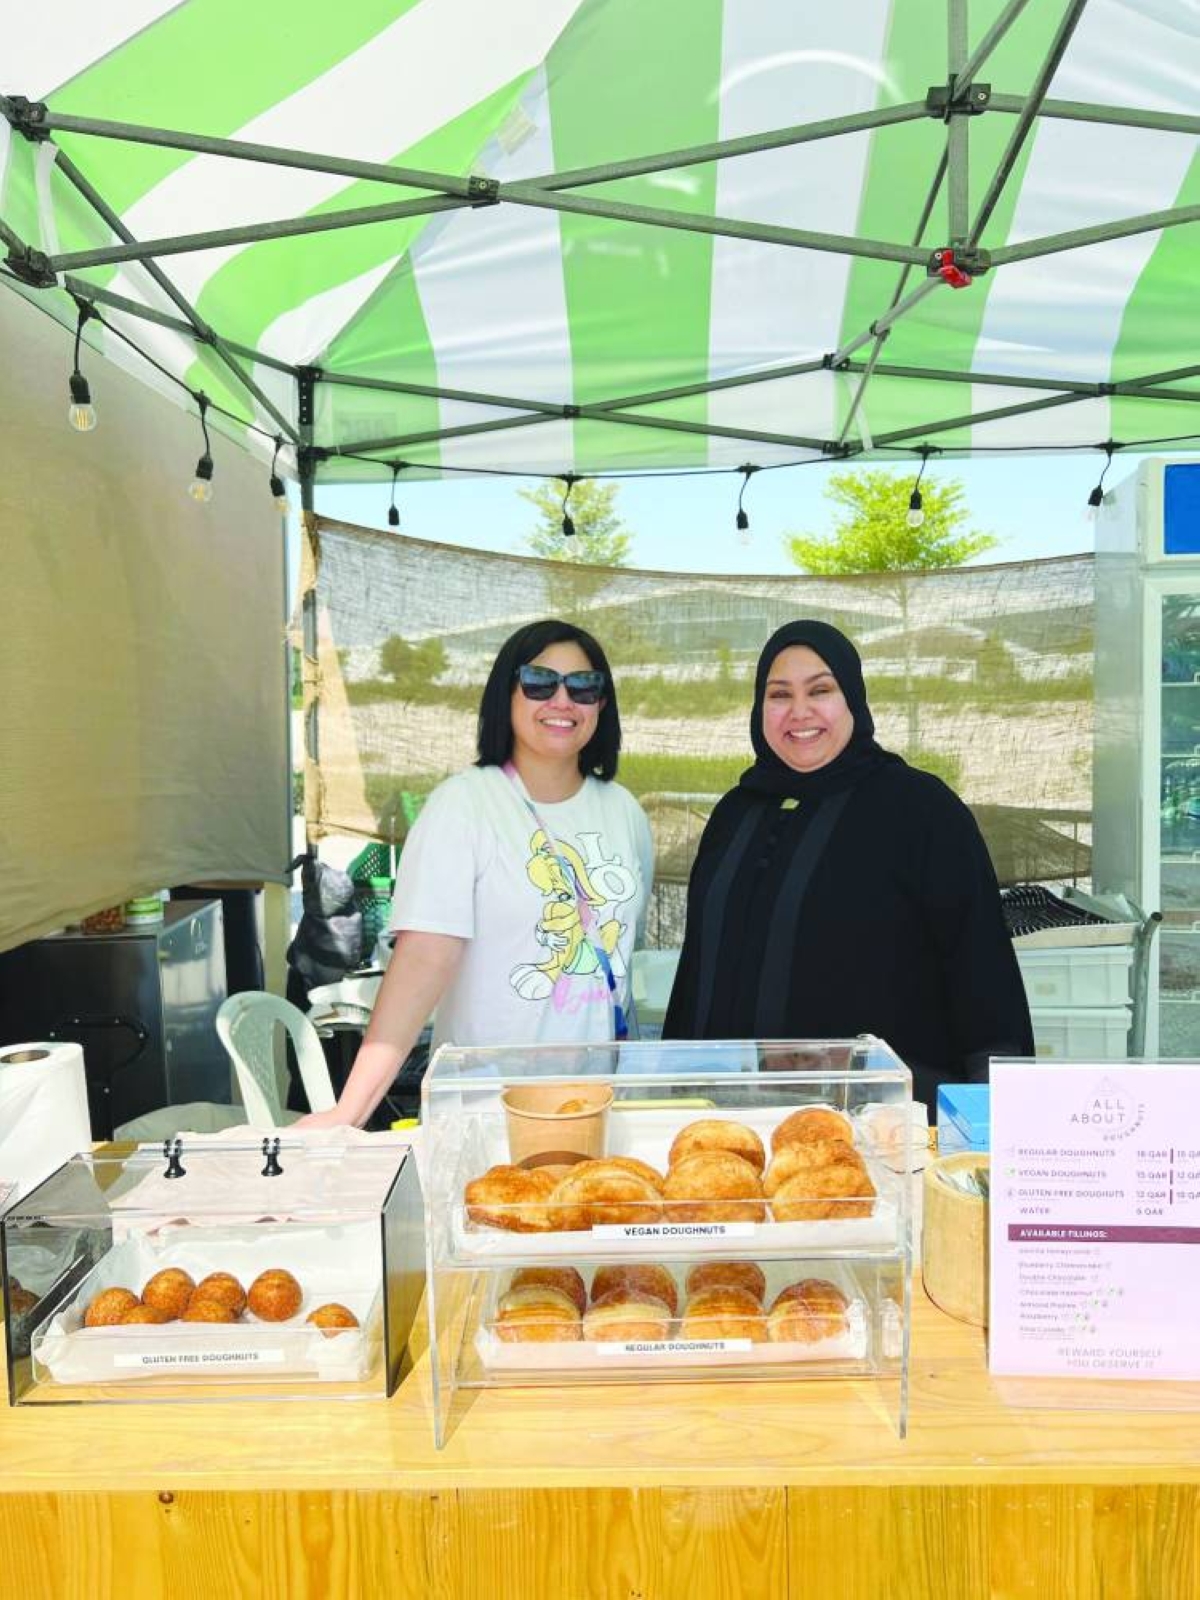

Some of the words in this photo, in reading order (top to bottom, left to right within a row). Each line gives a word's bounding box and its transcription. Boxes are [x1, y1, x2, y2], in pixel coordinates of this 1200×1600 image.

[1093, 1099, 1125, 1110] ALL
[1070, 1113, 1126, 1124] ABOUT
[1018, 1148, 1058, 1156] REGULAR
[1060, 1149, 1116, 1158] DOUGHNUTS
[1018, 1169, 1049, 1177] VEGAN
[1051, 1170, 1107, 1178] DOUGHNUTS
[1018, 1188, 1052, 1197] GLUTEN
[624, 1226, 660, 1236] VEGAN
[662, 1225, 726, 1235] DOUGHNUTS
[1020, 1229, 1066, 1237] AVAILABLE
[1068, 1230, 1108, 1238] FILLINGS:
[625, 1343, 666, 1351] REGULAR
[668, 1342, 725, 1351] DOUGHNUTS
[142, 1355, 177, 1364] GLUTEN
[179, 1354, 199, 1363] FREE
[202, 1352, 259, 1362] DOUGHNUTS
